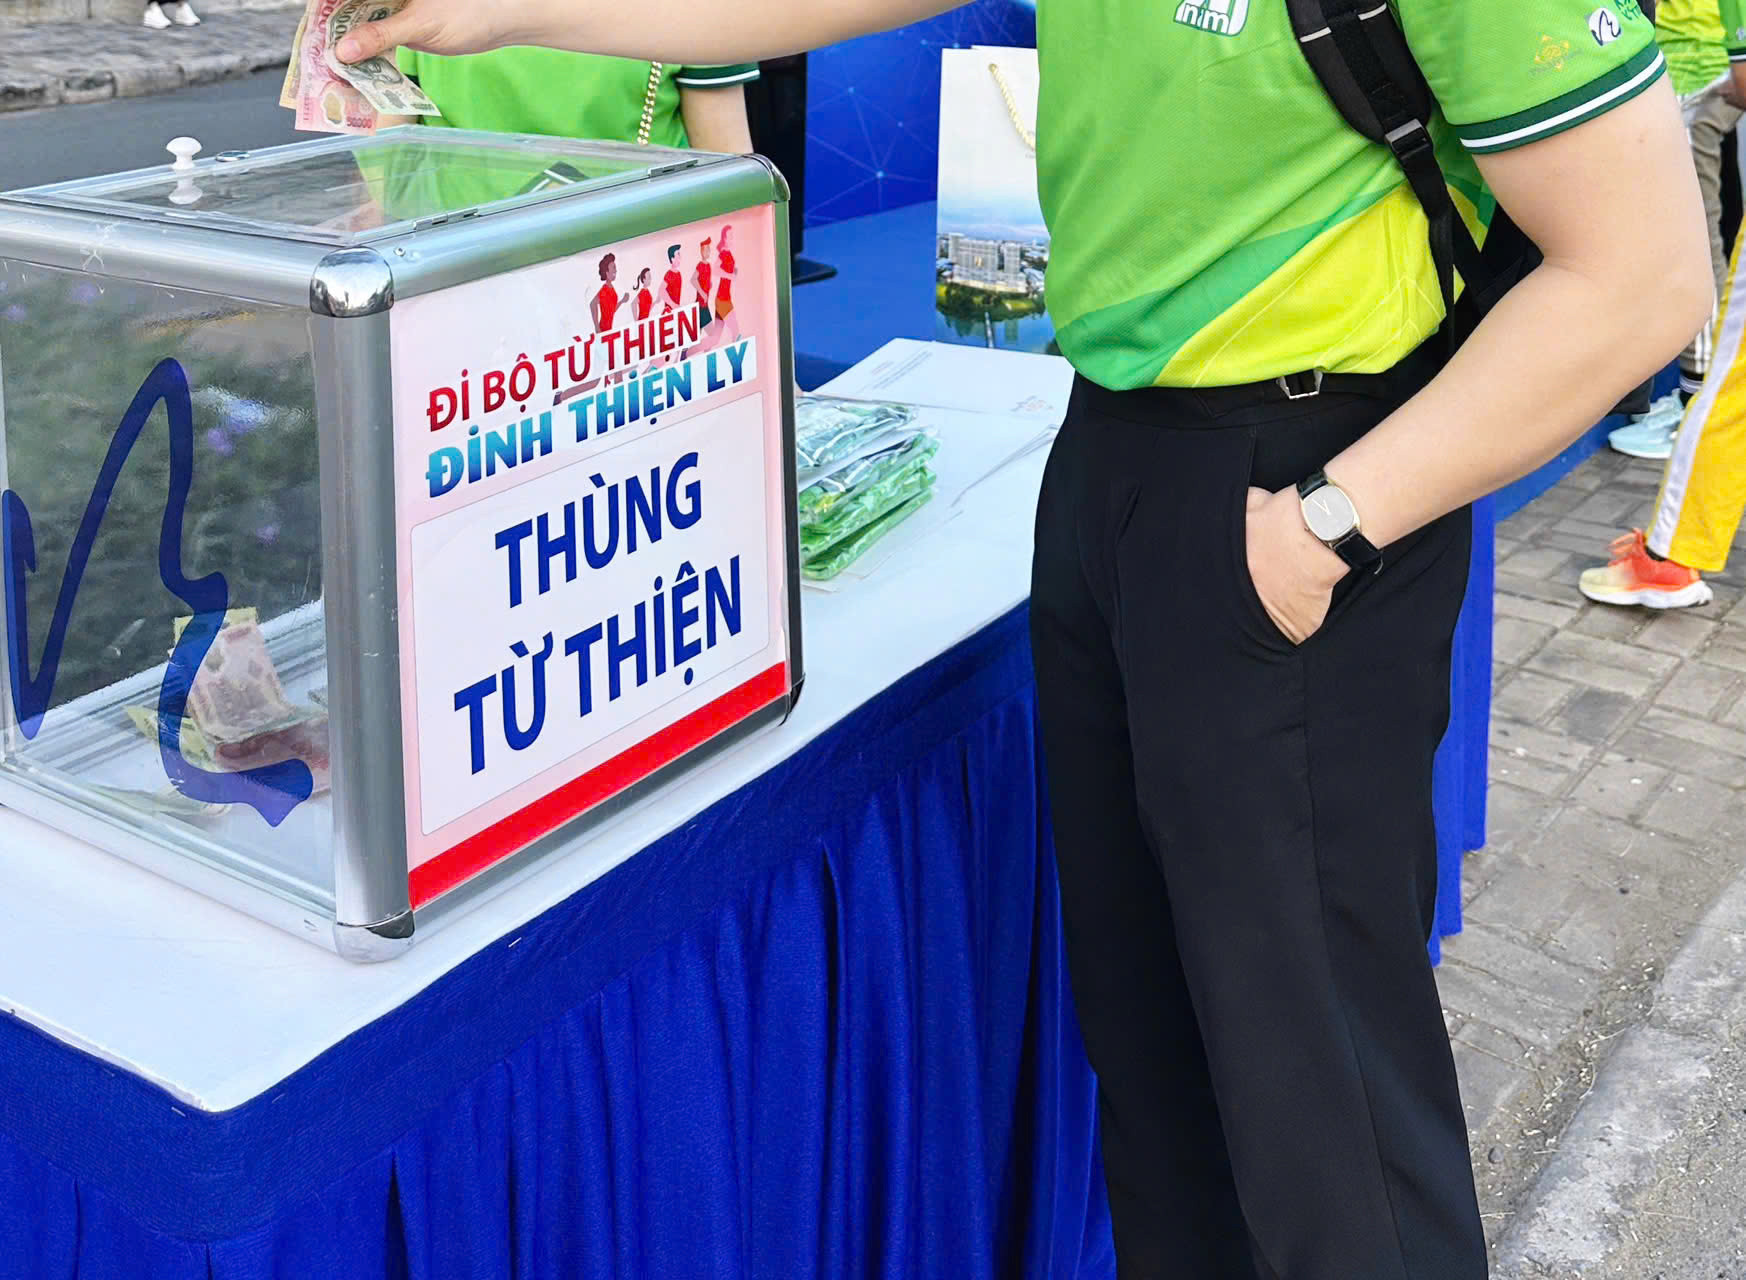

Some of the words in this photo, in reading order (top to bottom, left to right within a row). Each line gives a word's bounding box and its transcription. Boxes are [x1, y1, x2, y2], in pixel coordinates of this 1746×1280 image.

[483, 353, 536, 413] BỘ
[544, 333, 595, 390] TỪ
[601, 304, 698, 370] THIỆN
[568, 360, 692, 443] THIỆN
[495, 451, 701, 609] THÙNG
[454, 633, 554, 776] TỪ
[564, 554, 742, 719] THIỆN
